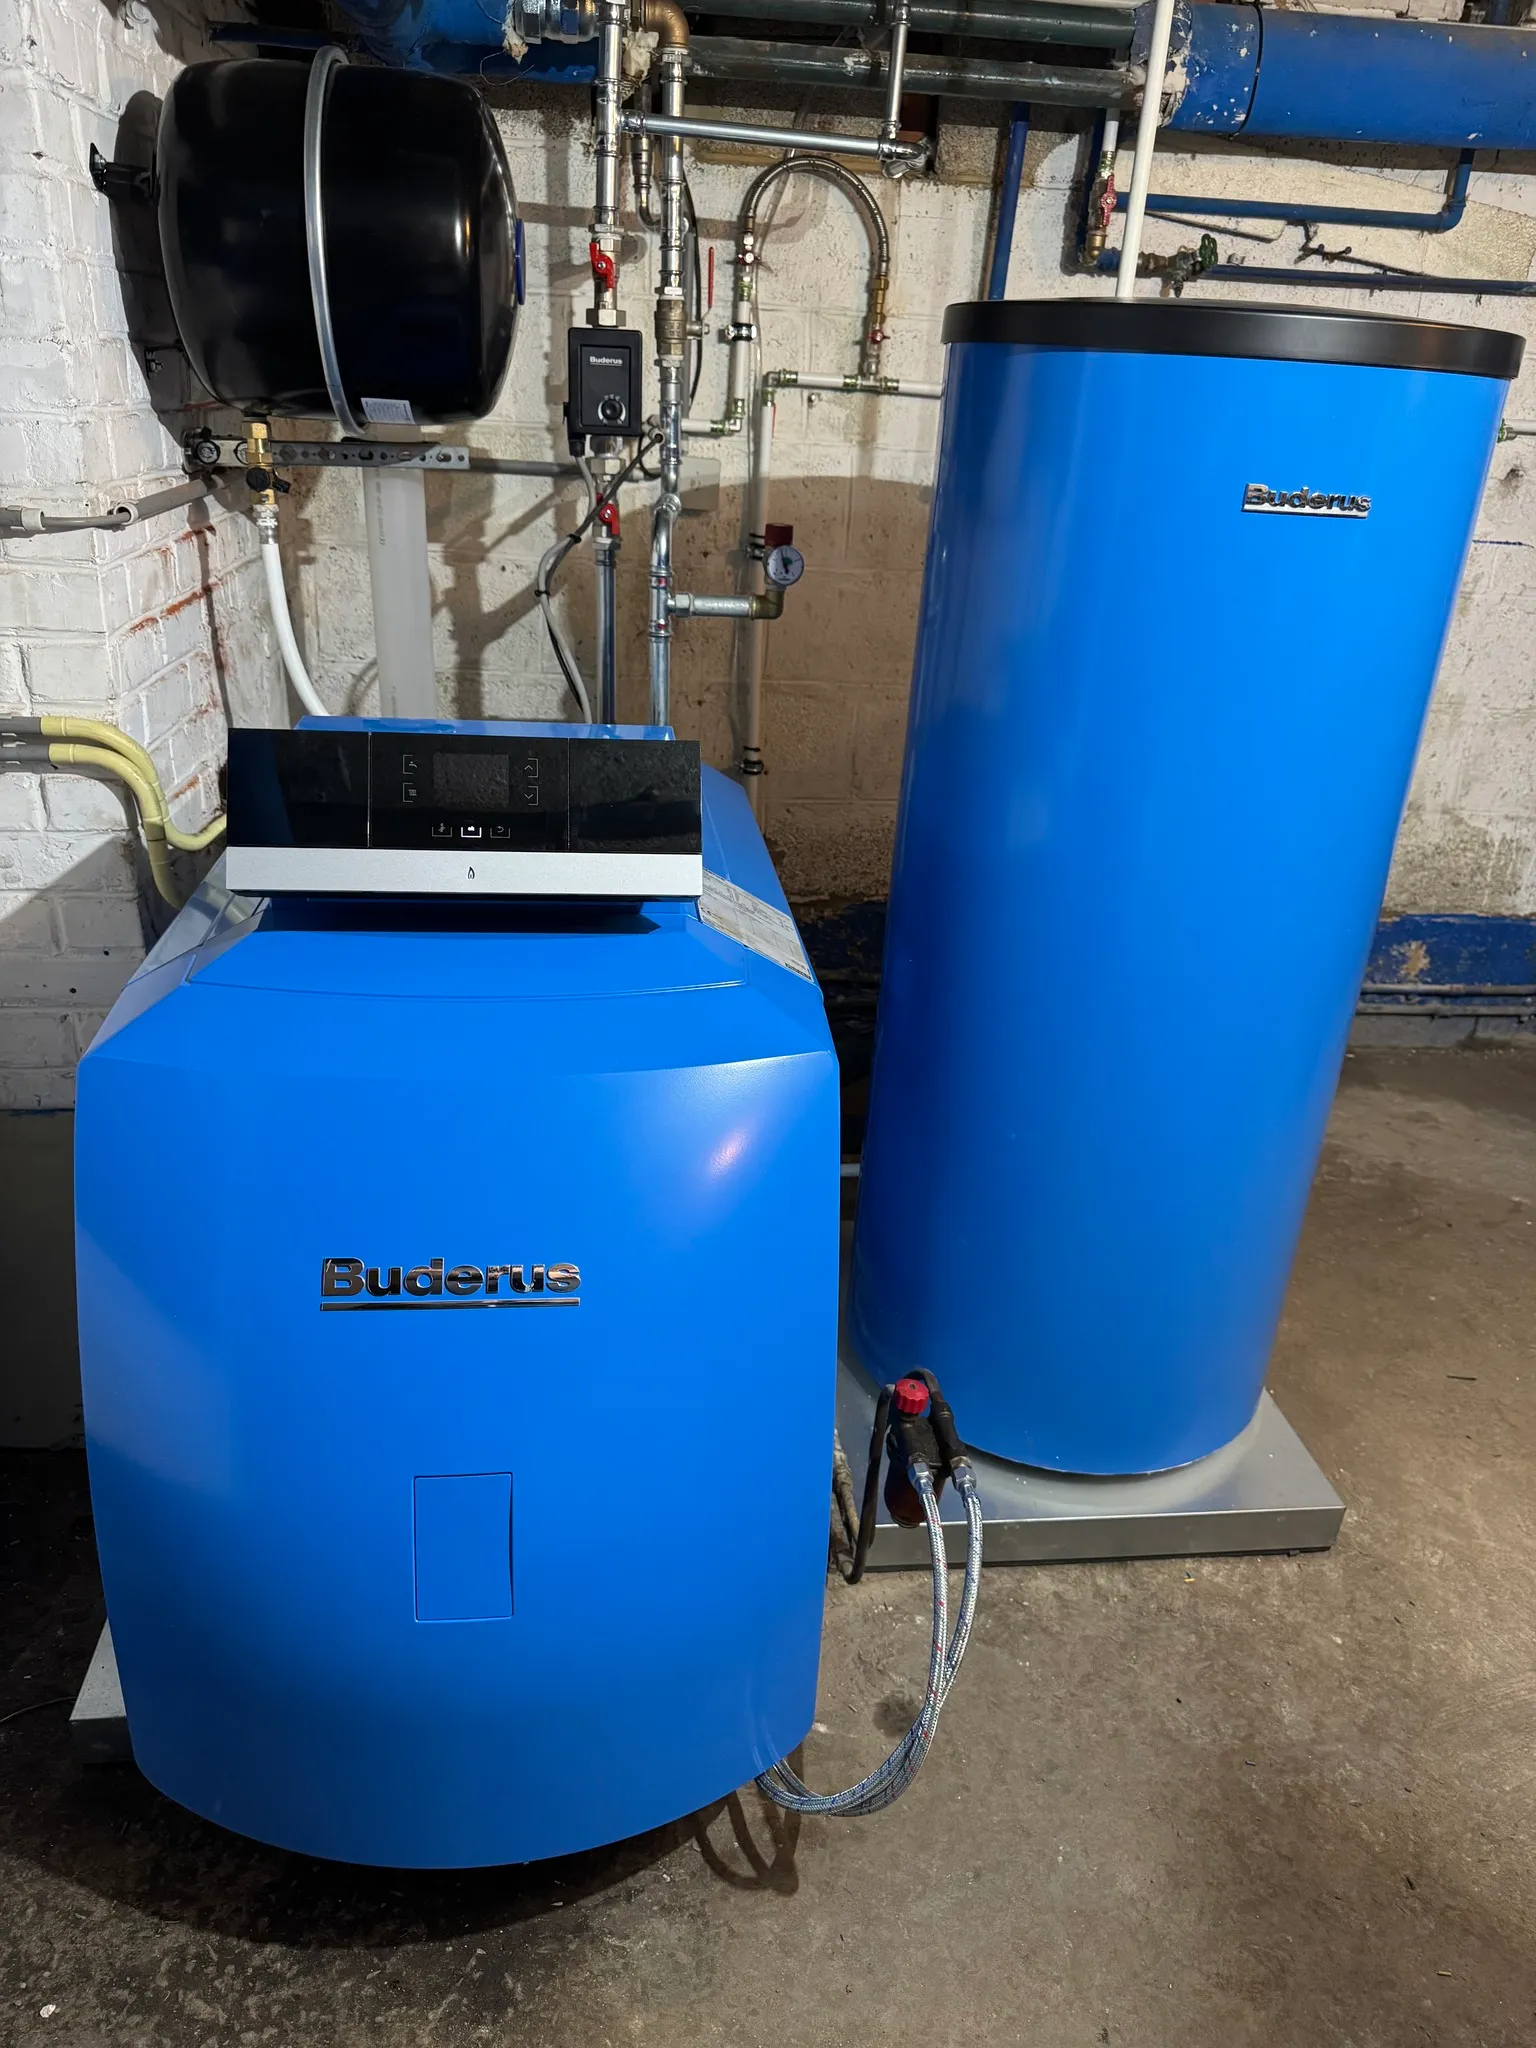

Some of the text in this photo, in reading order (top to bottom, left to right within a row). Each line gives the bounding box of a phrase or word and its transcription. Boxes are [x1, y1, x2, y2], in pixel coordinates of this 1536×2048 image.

[589, 355, 623, 365] Buderus
[1244, 483, 1371, 513] Buderus
[321, 1257, 581, 1297] Buderus
